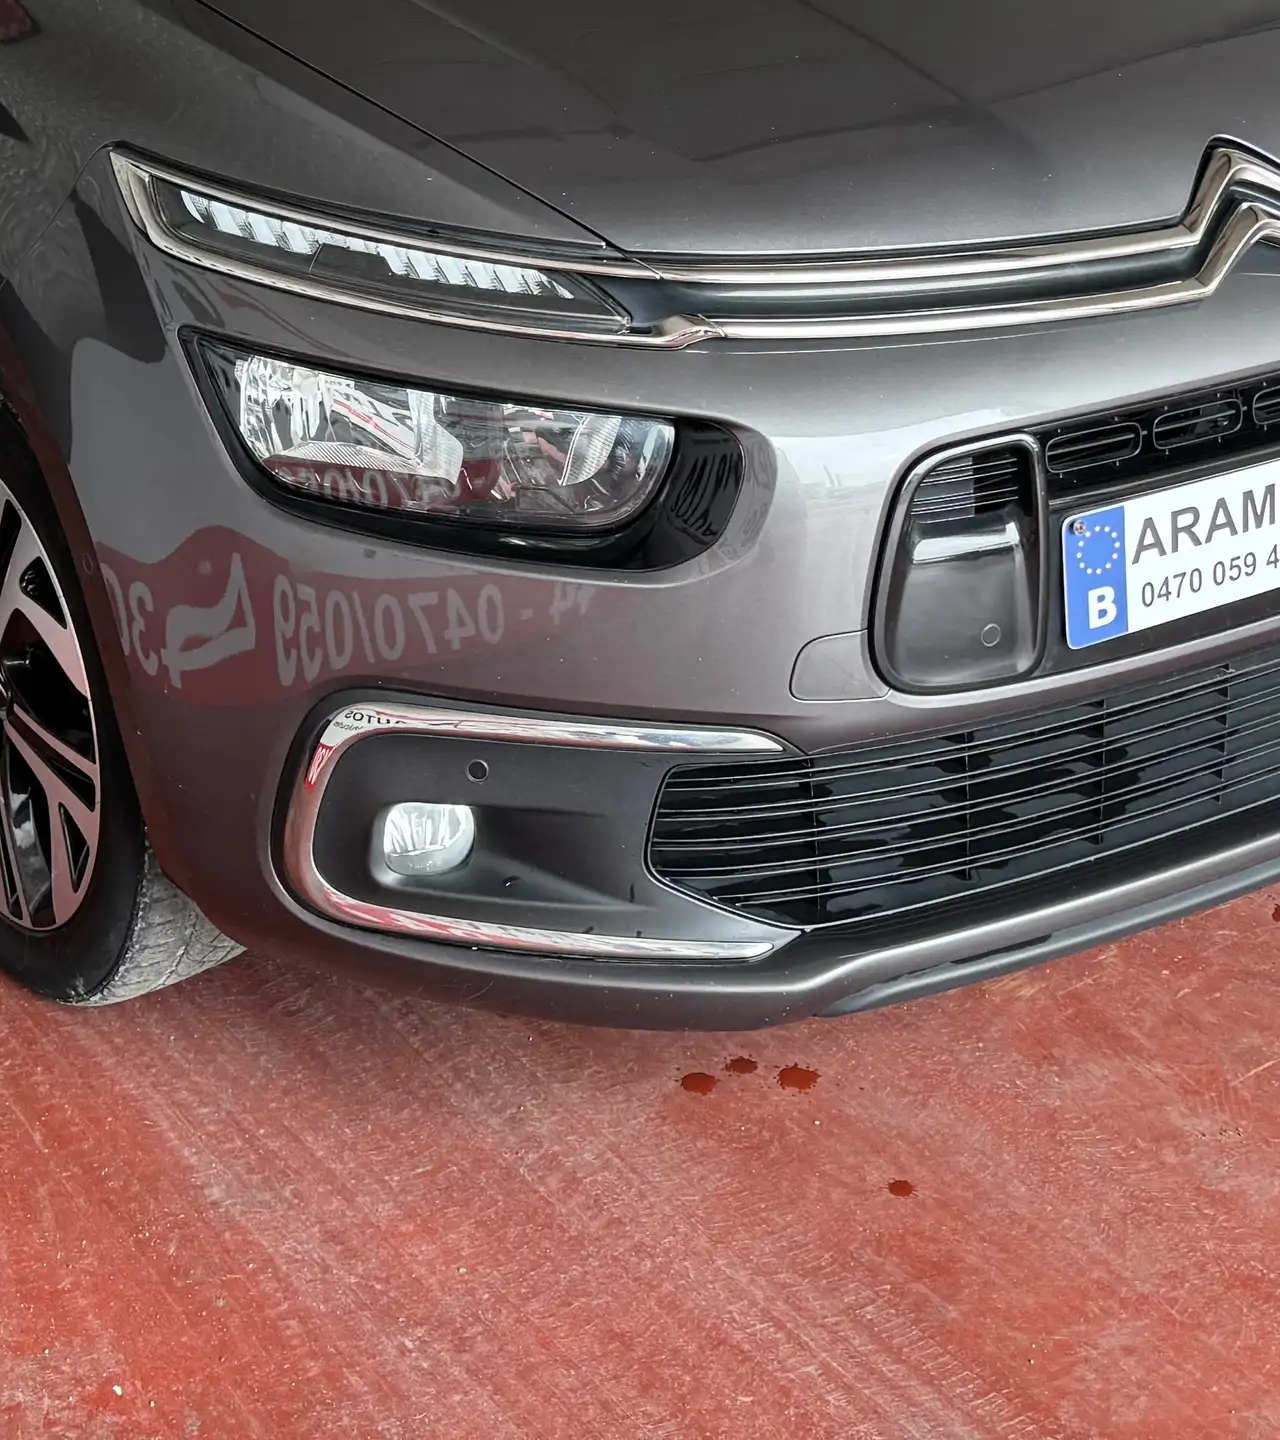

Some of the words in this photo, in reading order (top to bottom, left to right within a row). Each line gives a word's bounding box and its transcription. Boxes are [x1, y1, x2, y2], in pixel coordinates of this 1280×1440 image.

[1140, 568, 1202, 608] 0470
[1213, 551, 1257, 587] 059
[1087, 585, 1117, 630] B
